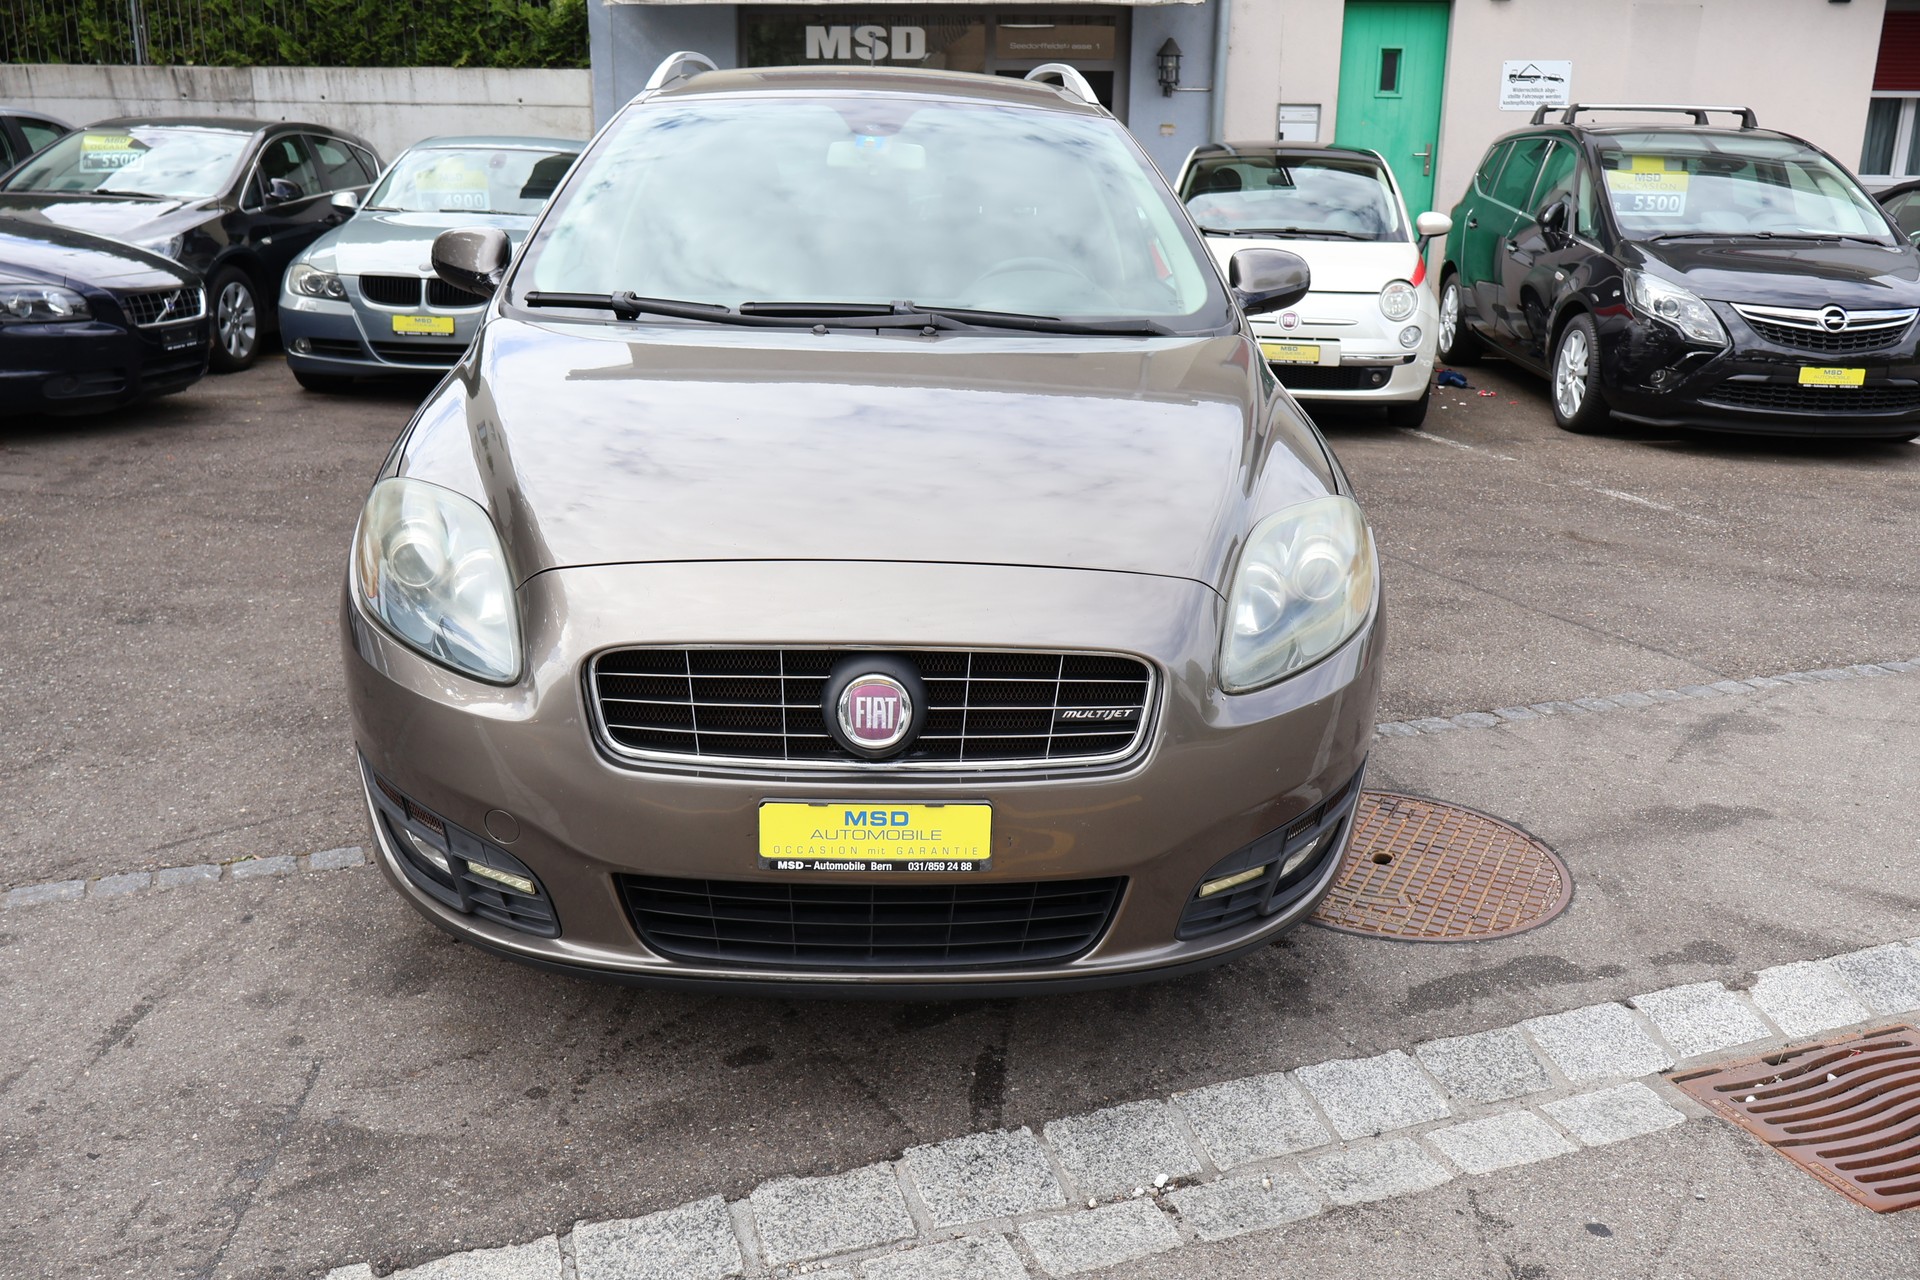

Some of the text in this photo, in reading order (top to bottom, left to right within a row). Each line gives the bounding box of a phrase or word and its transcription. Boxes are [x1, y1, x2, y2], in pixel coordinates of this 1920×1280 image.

[805, 26, 926, 60] MSD
[1634, 173, 1662, 182] MSD
[443, 193, 484, 208] 4900
[1633, 195, 1680, 211] 5500
[856, 696, 897, 729] FIAT
[1062, 709, 1133, 721] MULTIJET
[844, 810, 909, 827] MSD
[810, 829, 942, 841] AUTOMOBILE
[773, 845, 858, 854] OCCASION
[896, 847, 978, 855] GARANTIE
[870, 862, 892, 871] Bern
[907, 862, 945, 871] 031/859
[946, 862, 958, 871] 24
[960, 862, 972, 871] 88
